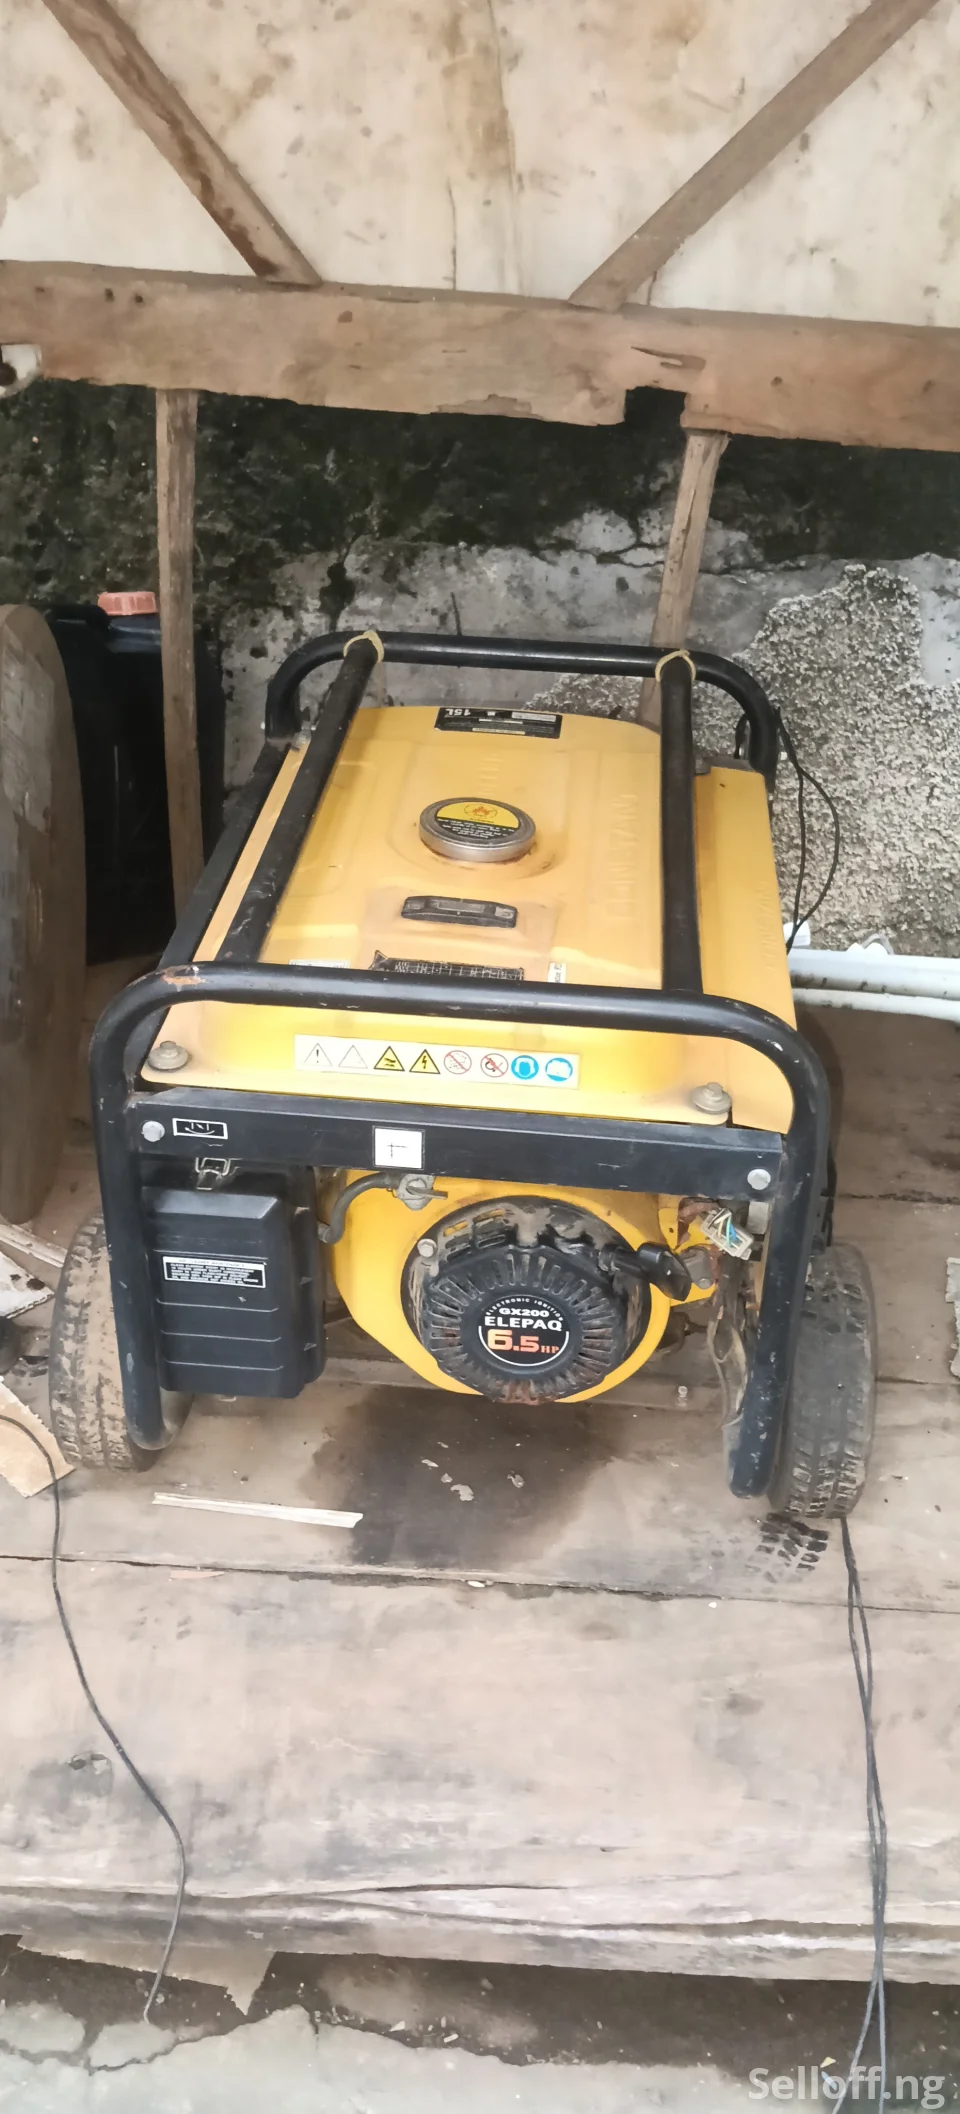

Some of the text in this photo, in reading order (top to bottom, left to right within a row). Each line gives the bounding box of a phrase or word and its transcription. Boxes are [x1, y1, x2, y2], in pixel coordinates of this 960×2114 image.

[444, 708, 471, 717] 15L
[485, 1297, 564, 1321] ELECTRONIC IGNITION
[498, 1308, 550, 1317] GX200
[484, 1316, 562, 1331] ELEPAQ
[487, 1328, 560, 1354] 6.5 HP
